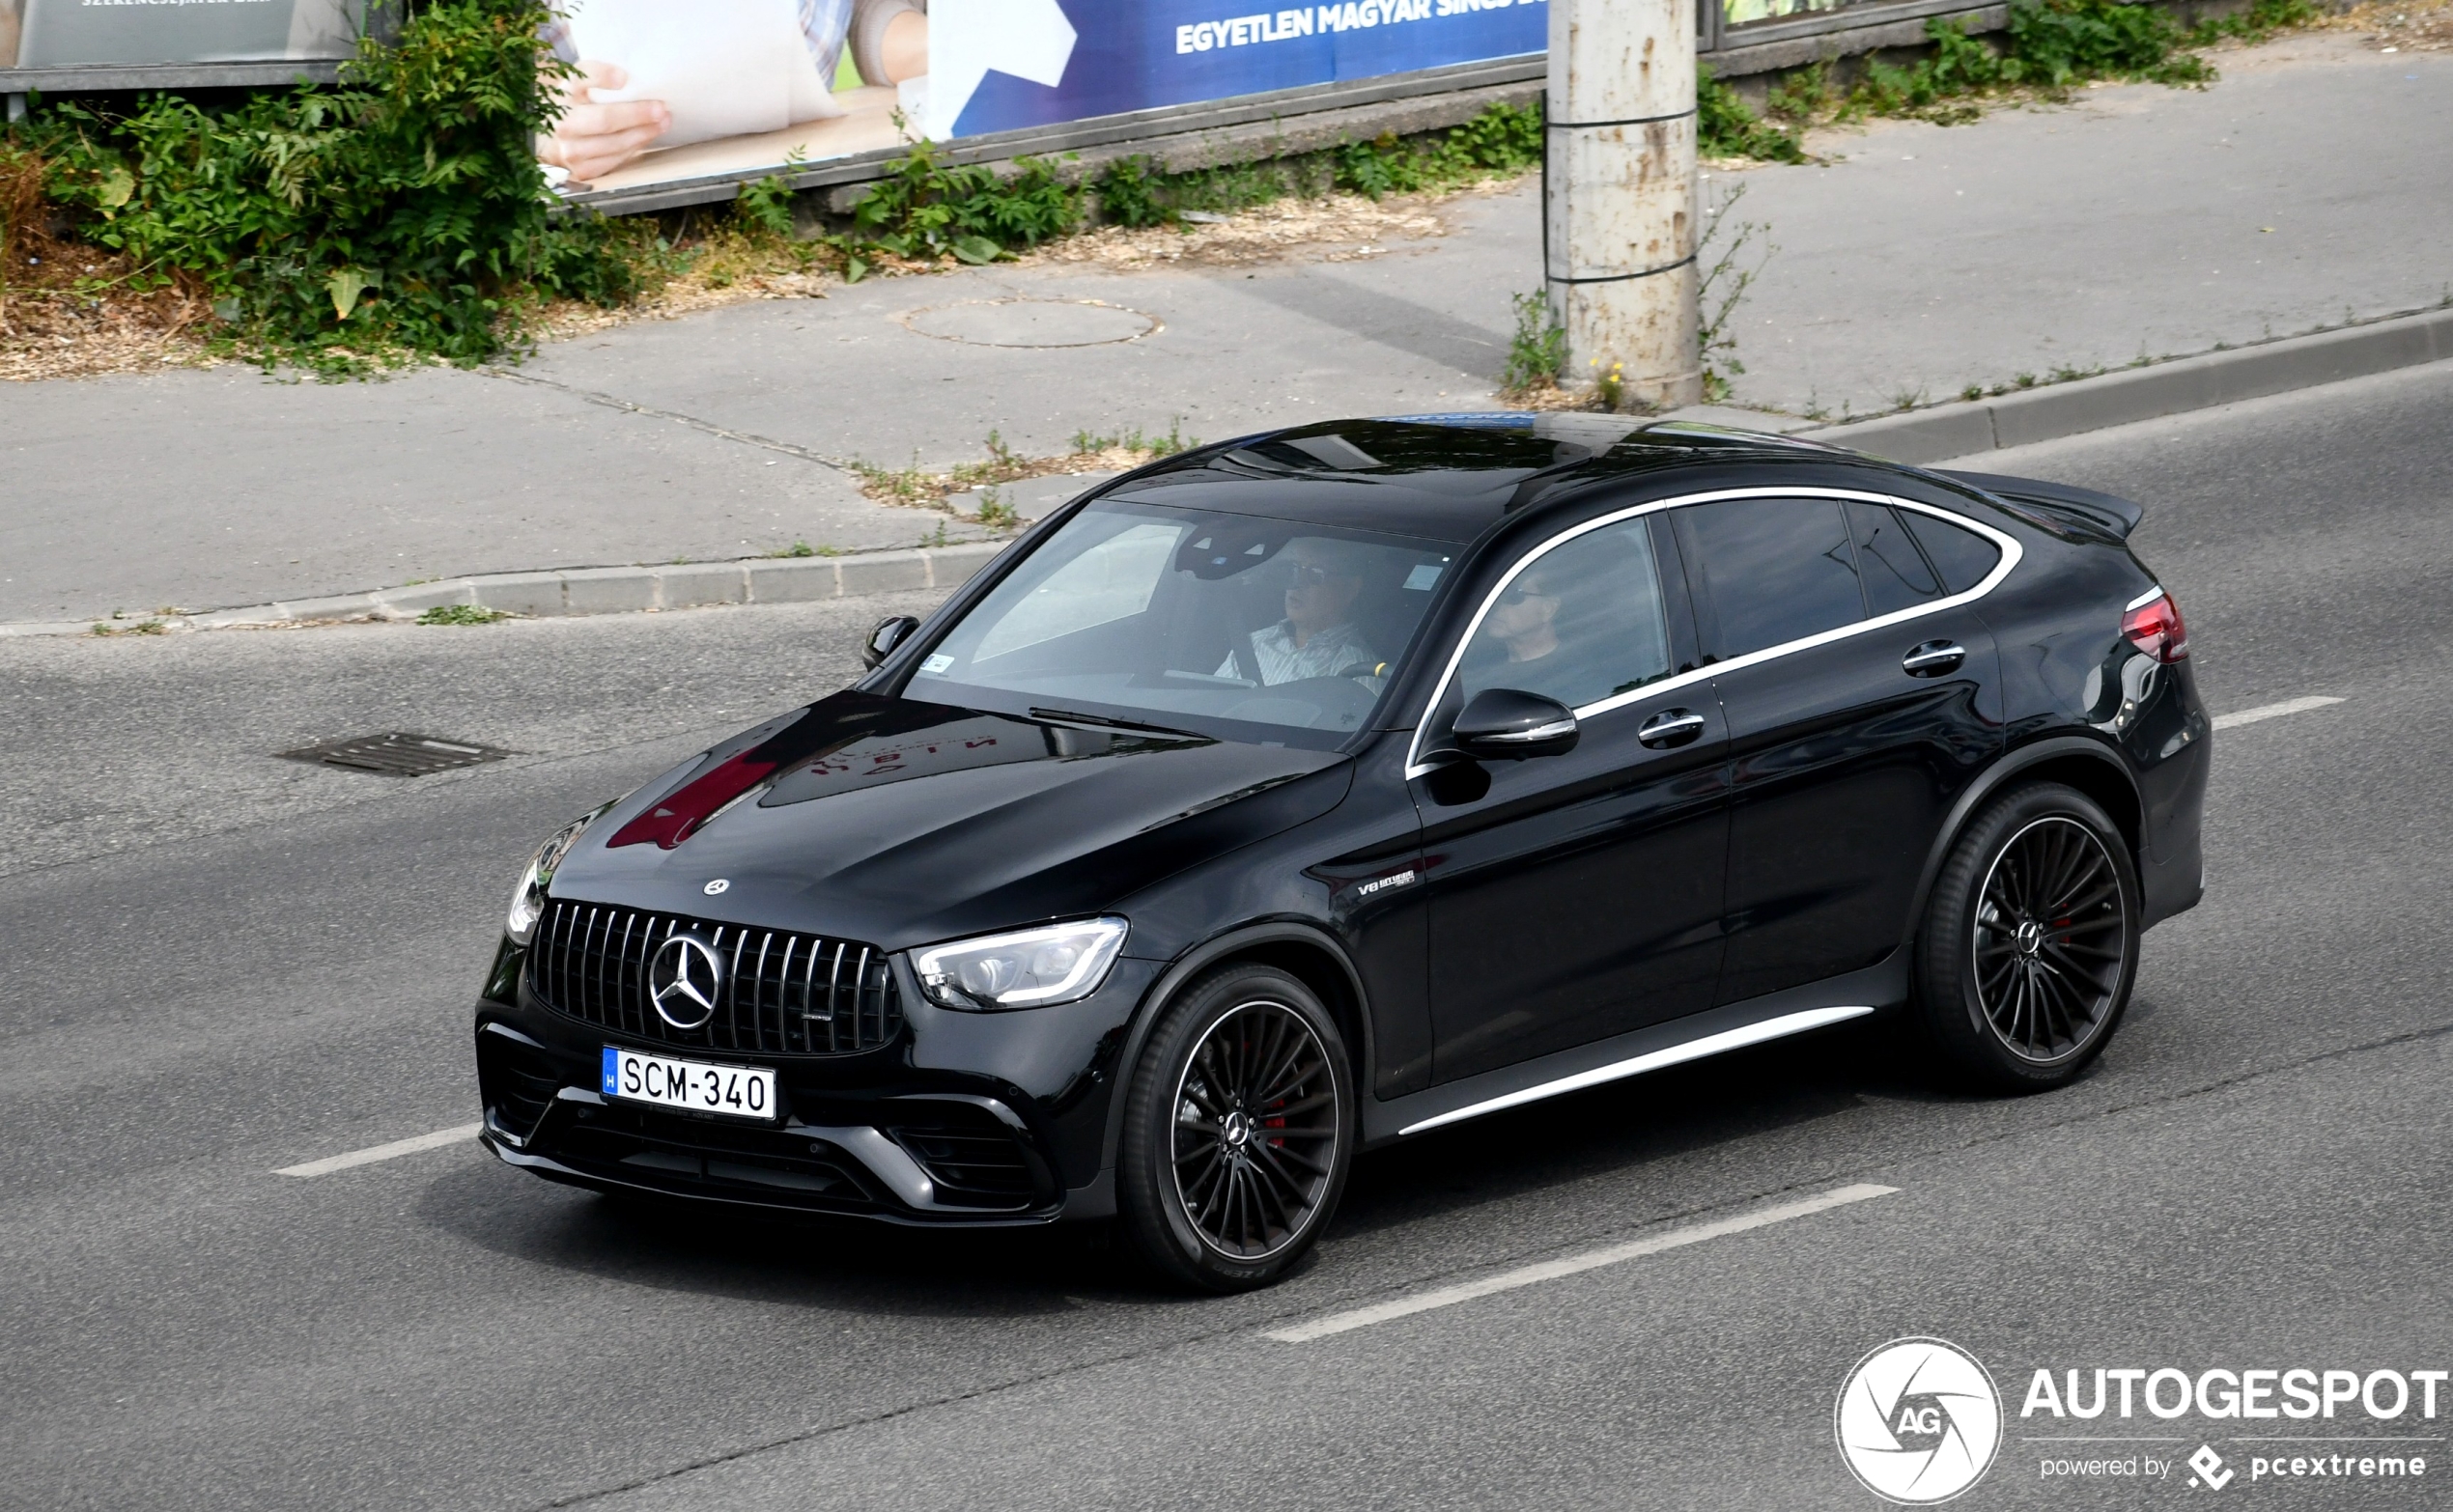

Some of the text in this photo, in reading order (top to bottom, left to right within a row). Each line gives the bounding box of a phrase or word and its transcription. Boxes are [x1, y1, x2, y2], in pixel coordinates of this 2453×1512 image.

[1175, 9, 1313, 55] EGYETLEN
[1318, 0, 1432, 34] MAGYAR
[1357, 882, 1379, 896] V8
[606, 1057, 765, 1111] H SCM-340
